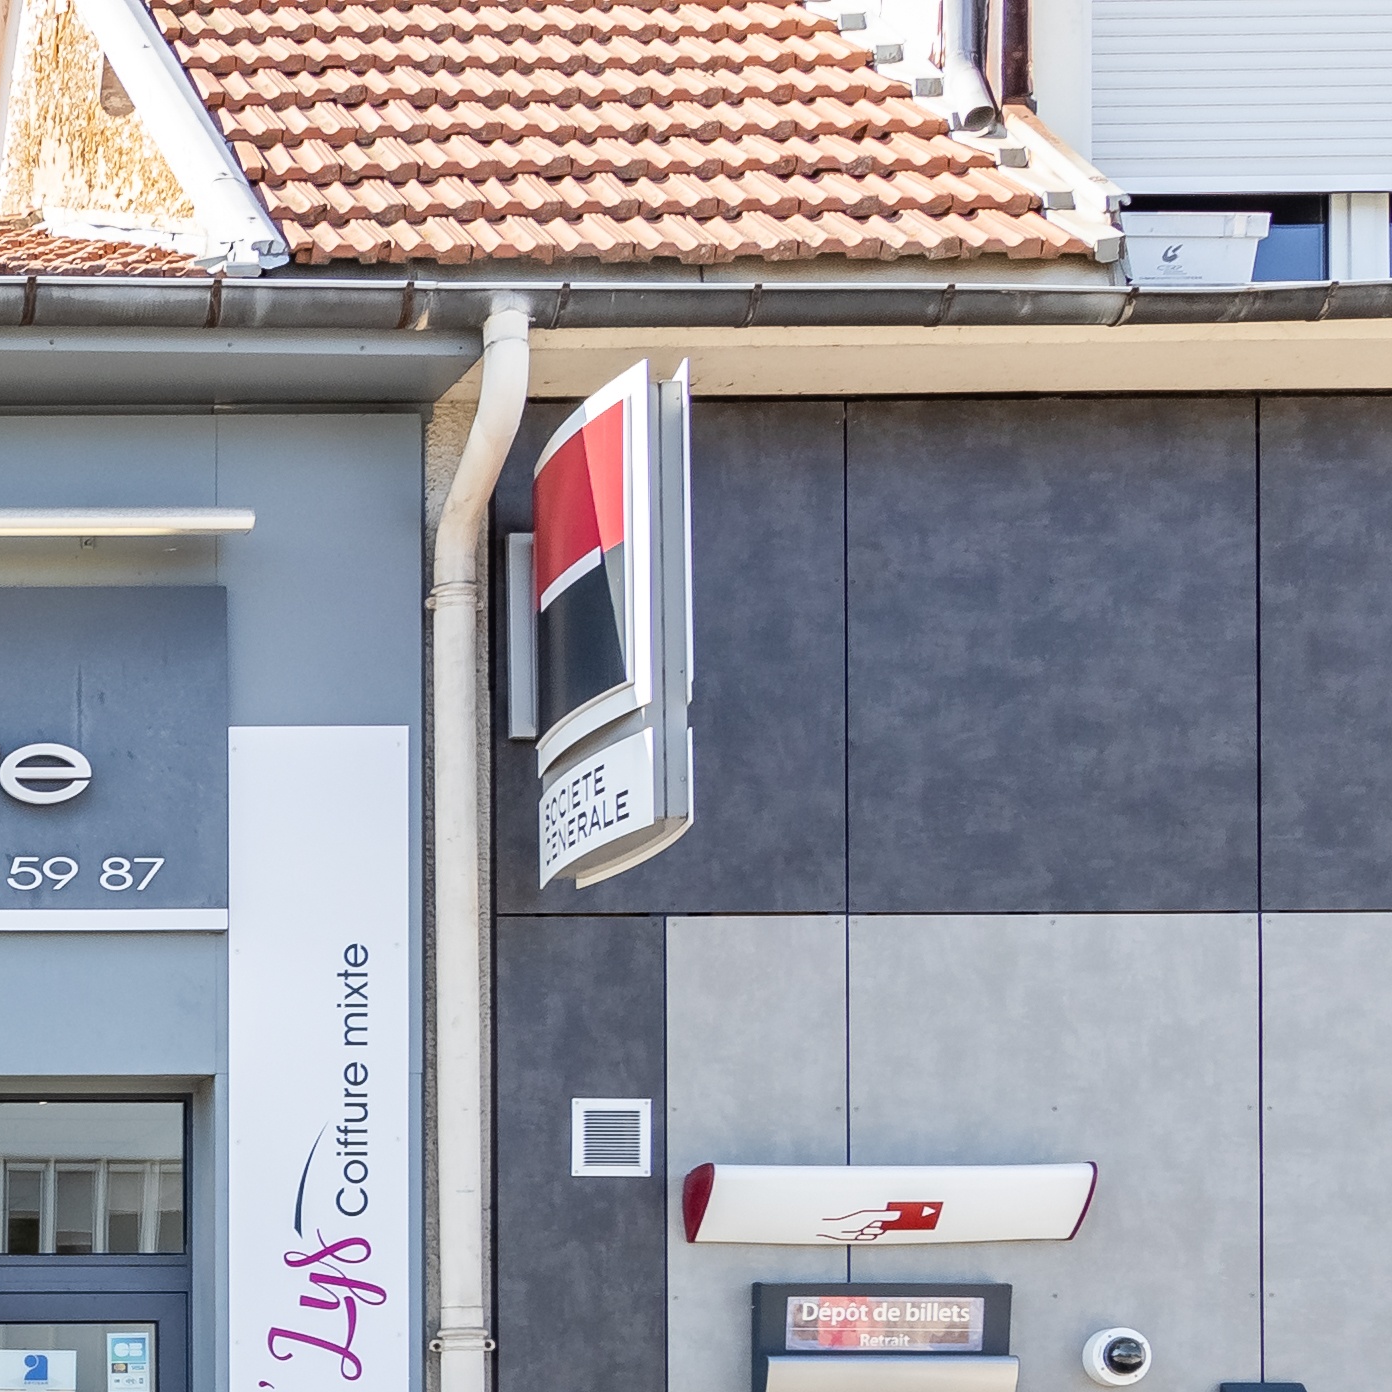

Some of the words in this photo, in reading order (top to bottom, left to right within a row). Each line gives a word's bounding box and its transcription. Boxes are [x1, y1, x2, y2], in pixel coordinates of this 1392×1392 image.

[7, 858, 79, 891] 59
[99, 858, 165, 891] 87
[336, 943, 369, 1046] mixte
[335, 1061, 369, 1217] Coiffure
[802, 1302, 868, 1325] Dépôt
[873, 1302, 900, 1322] de
[906, 1302, 971, 1322] billets
[860, 1333, 911, 1347] Retrait
